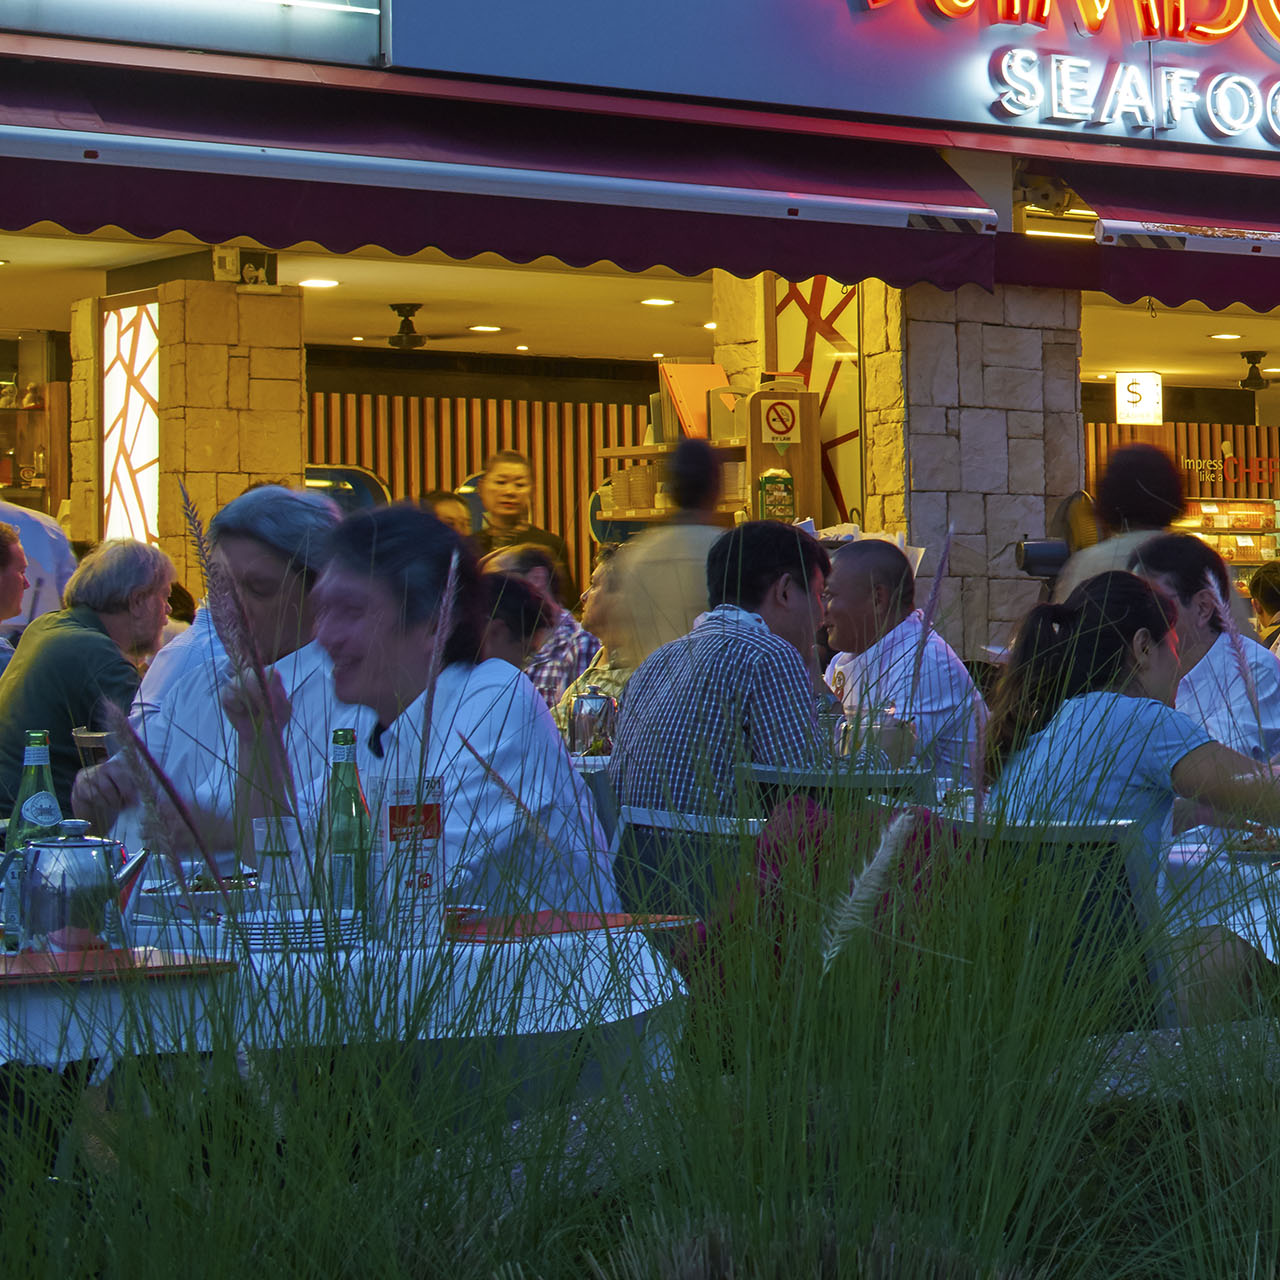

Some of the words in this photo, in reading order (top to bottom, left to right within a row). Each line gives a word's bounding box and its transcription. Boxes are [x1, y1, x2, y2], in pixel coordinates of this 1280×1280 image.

[1181, 455, 1224, 472] Impress
[1223, 455, 1280, 484] CHEF
[1199, 470, 1216, 482] like
[1218, 473, 1224, 482] a
